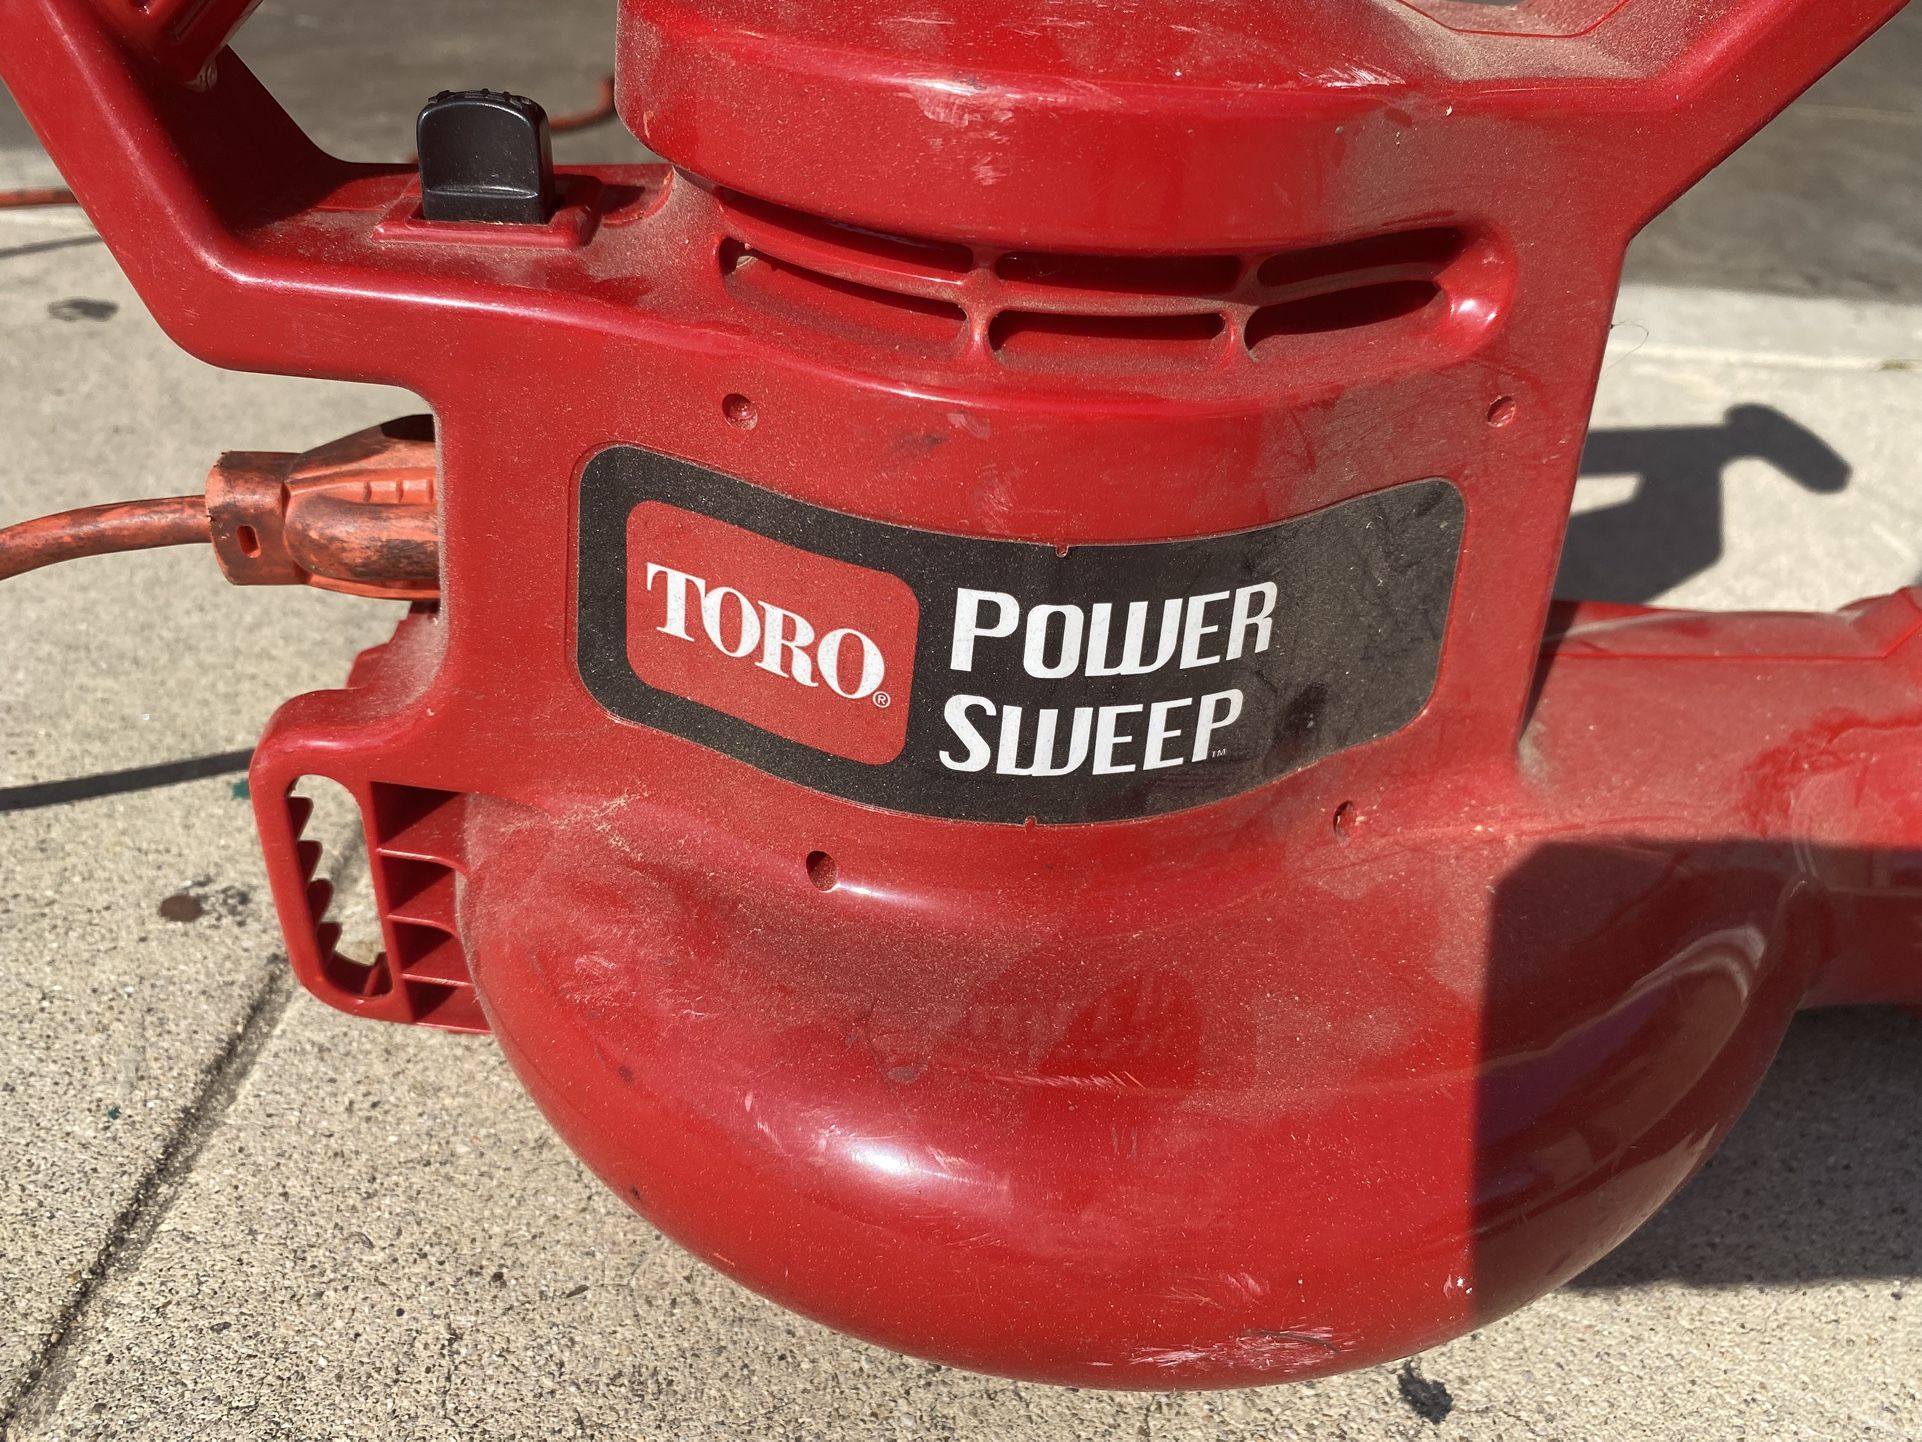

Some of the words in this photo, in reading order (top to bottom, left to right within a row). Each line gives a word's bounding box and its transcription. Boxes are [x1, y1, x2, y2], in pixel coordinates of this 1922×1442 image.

[647, 562, 885, 699] TORO
[950, 581, 1277, 679] POWER
[938, 688, 1244, 777] SWEEP
